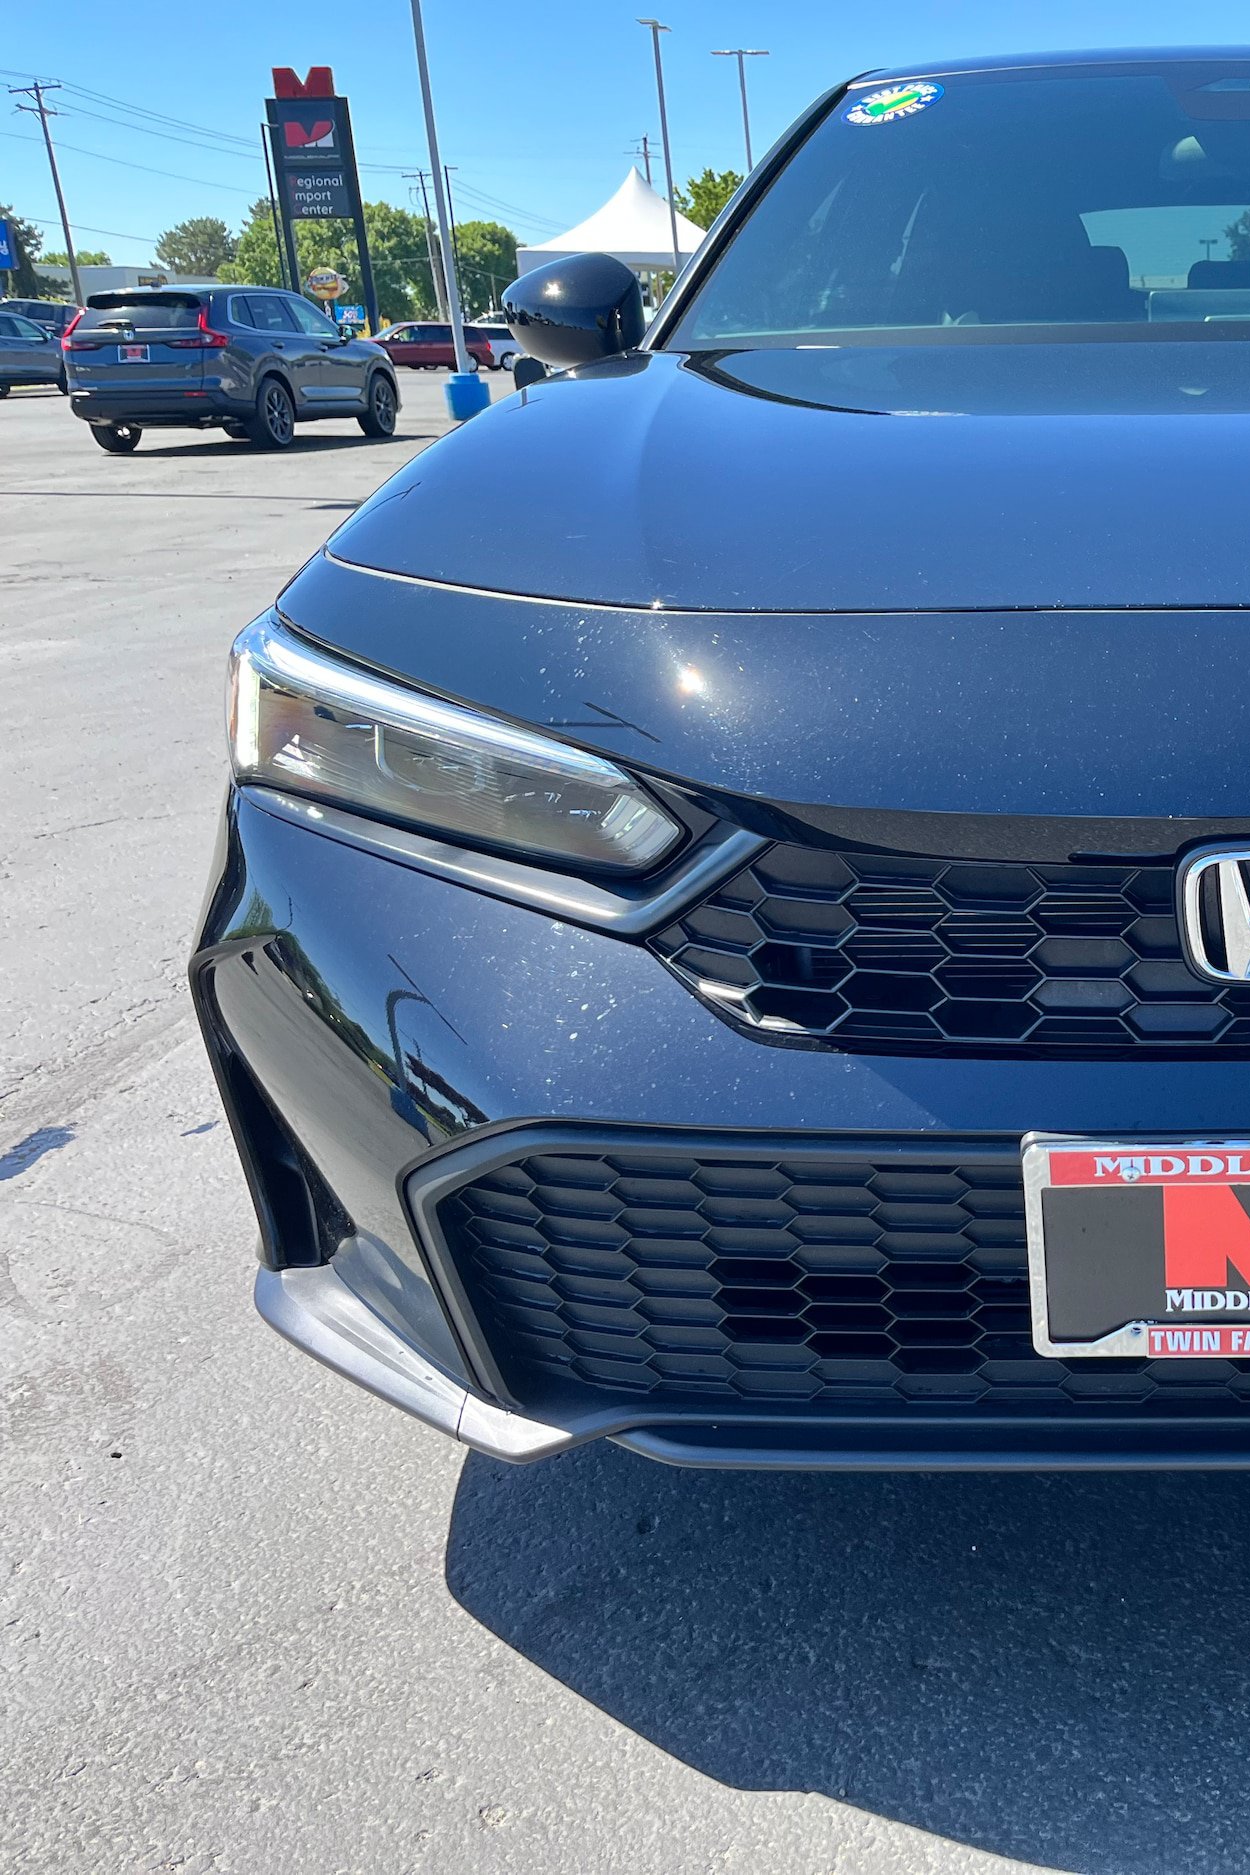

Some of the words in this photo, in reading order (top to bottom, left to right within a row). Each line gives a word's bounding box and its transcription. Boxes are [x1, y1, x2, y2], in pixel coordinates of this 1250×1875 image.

[272, 66, 334, 98] M
[289, 174, 343, 190] Regional
[292, 190, 331, 203] Import
[294, 205, 334, 215] Center
[1150, 1330, 1221, 1352] TWIN
